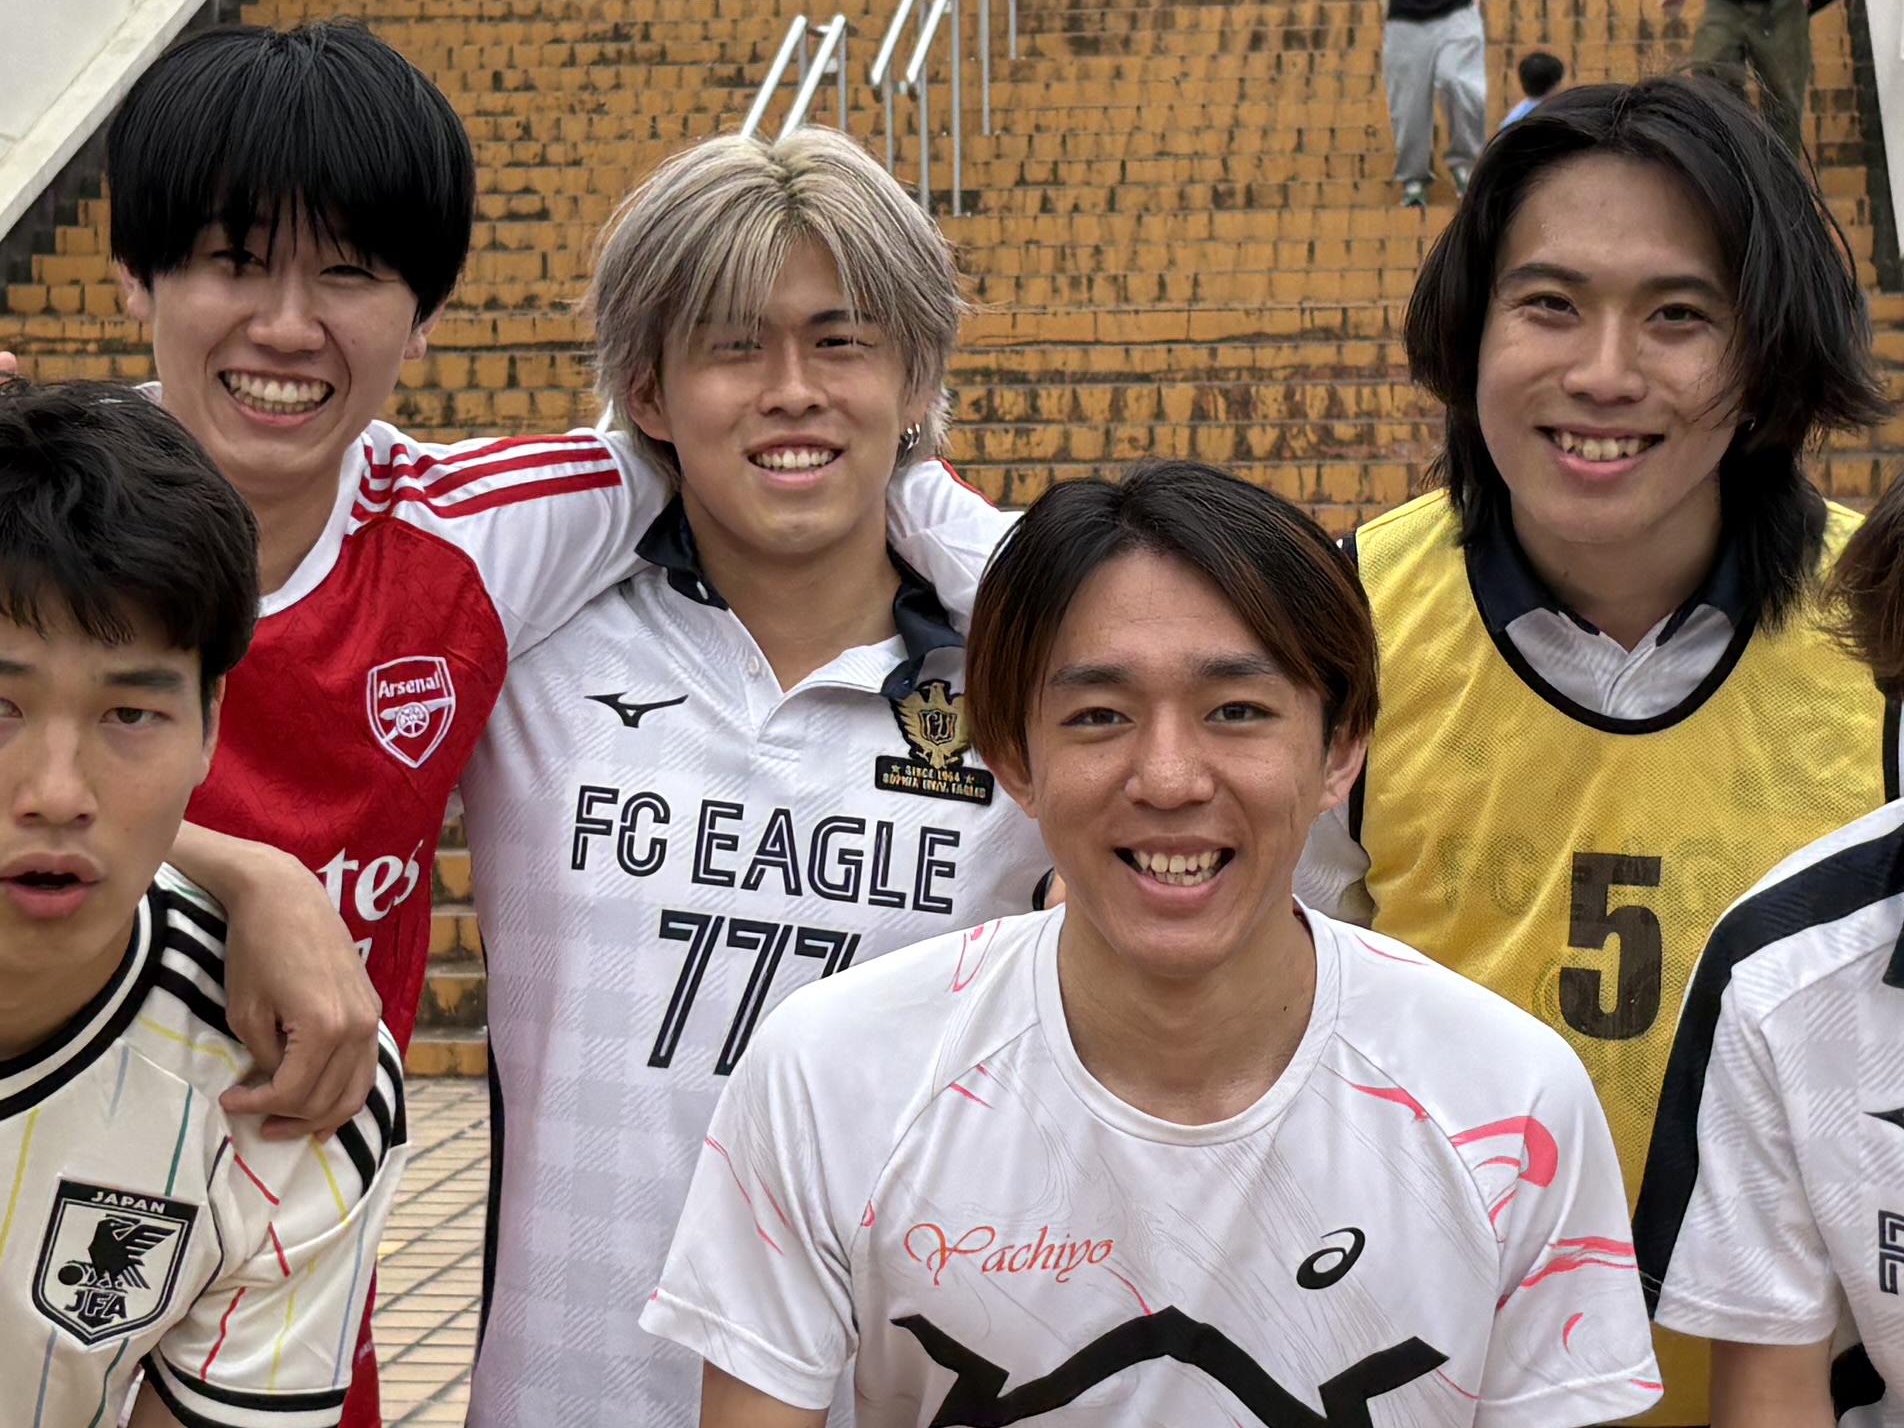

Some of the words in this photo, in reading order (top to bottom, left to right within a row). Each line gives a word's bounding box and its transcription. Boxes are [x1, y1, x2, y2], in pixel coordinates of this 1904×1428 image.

[379, 670, 440, 699] Arsenal
[570, 785, 673, 878] FC
[692, 798, 962, 915] EAGLE
[1558, 851, 1662, 1041] 5
[91, 1191, 166, 1215] JAPAN
[903, 1223, 1114, 1286] Yachiyo
[64, 1290, 128, 1319] JFA
